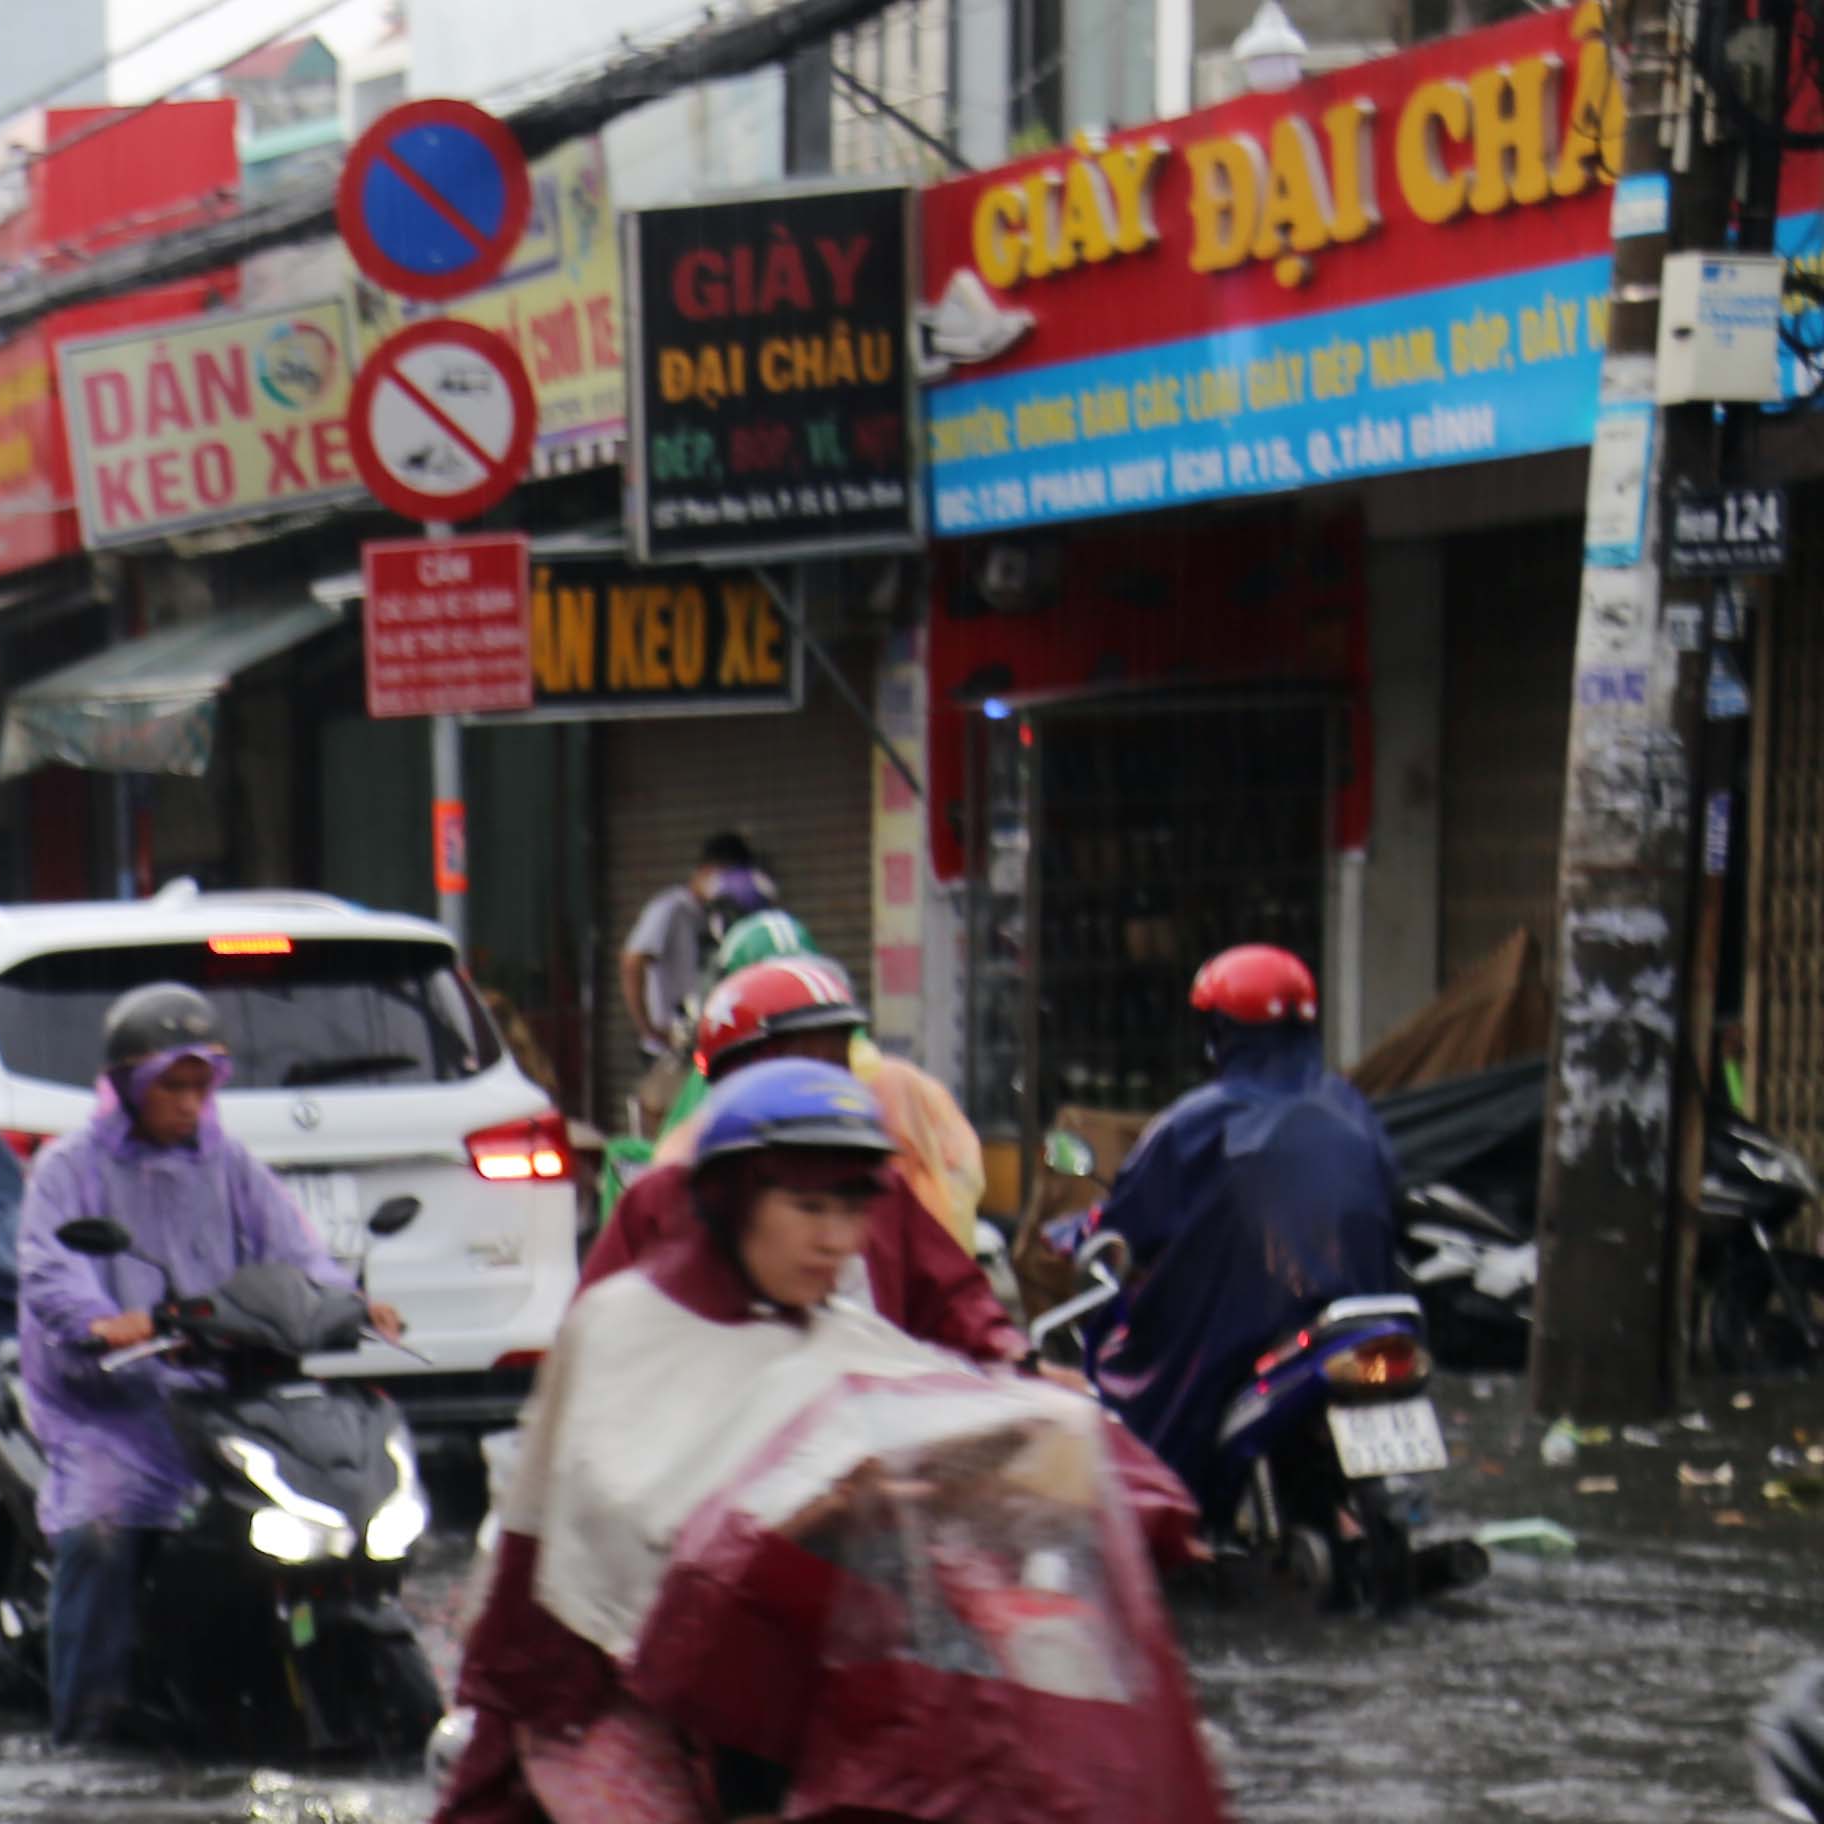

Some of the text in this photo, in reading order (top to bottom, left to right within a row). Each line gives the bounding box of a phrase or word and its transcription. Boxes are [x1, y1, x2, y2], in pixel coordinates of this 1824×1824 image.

[972, 0, 1626, 289] GIÀY ĐẠI CHÂ
[670, 222, 871, 322] GIÀY
[83, 340, 251, 448] DÁN
[658, 320, 893, 411] ĐẠI CHÂU
[94, 440, 234, 529] KEO
[1723, 489, 1781, 541] 124
[531, 565, 595, 694] ÁN
[608, 583, 706, 690] KEO
[717, 578, 783, 687] XE
